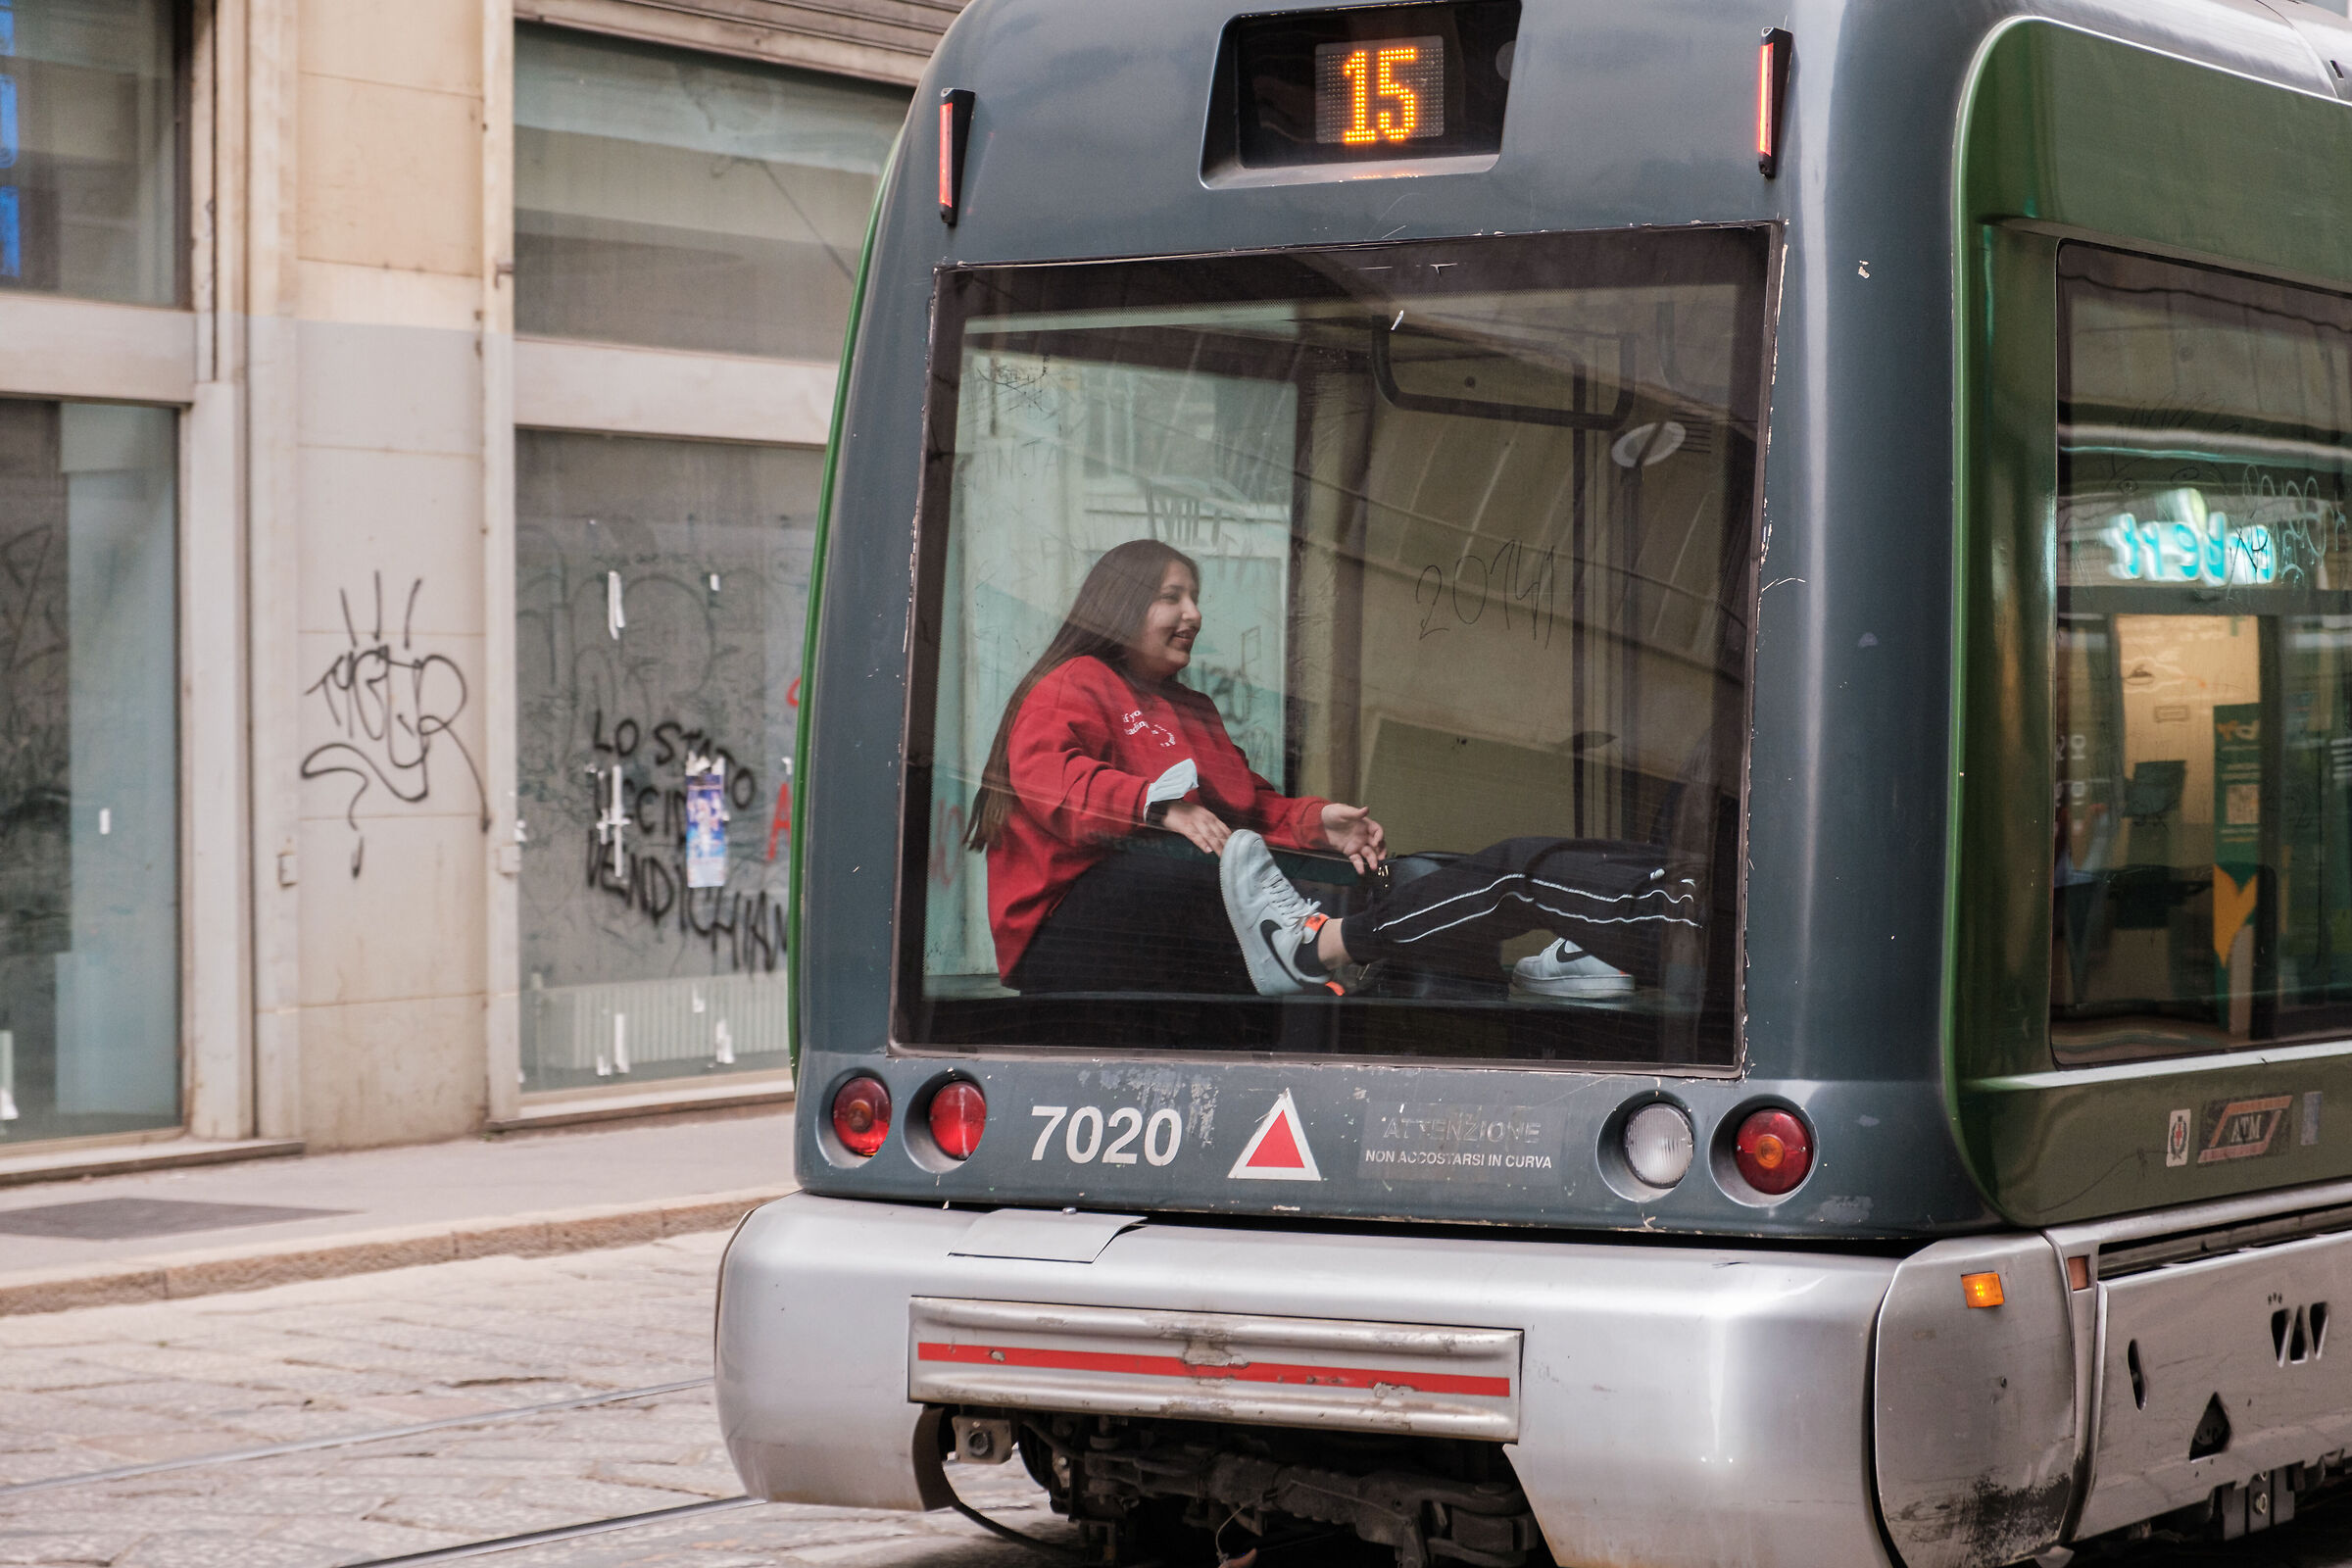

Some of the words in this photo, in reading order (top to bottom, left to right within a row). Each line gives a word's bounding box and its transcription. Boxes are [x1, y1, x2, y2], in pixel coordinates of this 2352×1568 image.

[1344, 47, 1416, 143] 15
[593, 709, 639, 758] LO
[1031, 1104, 1183, 1167] 7020
[1382, 1117, 1543, 1145] ATTENZIONE
[1365, 1150, 1396, 1164] NON
[1397, 1152, 1485, 1167] ACCOSTARSI
[1488, 1154, 1501, 1167] IN
[1505, 1154, 1552, 1169] CURVA
